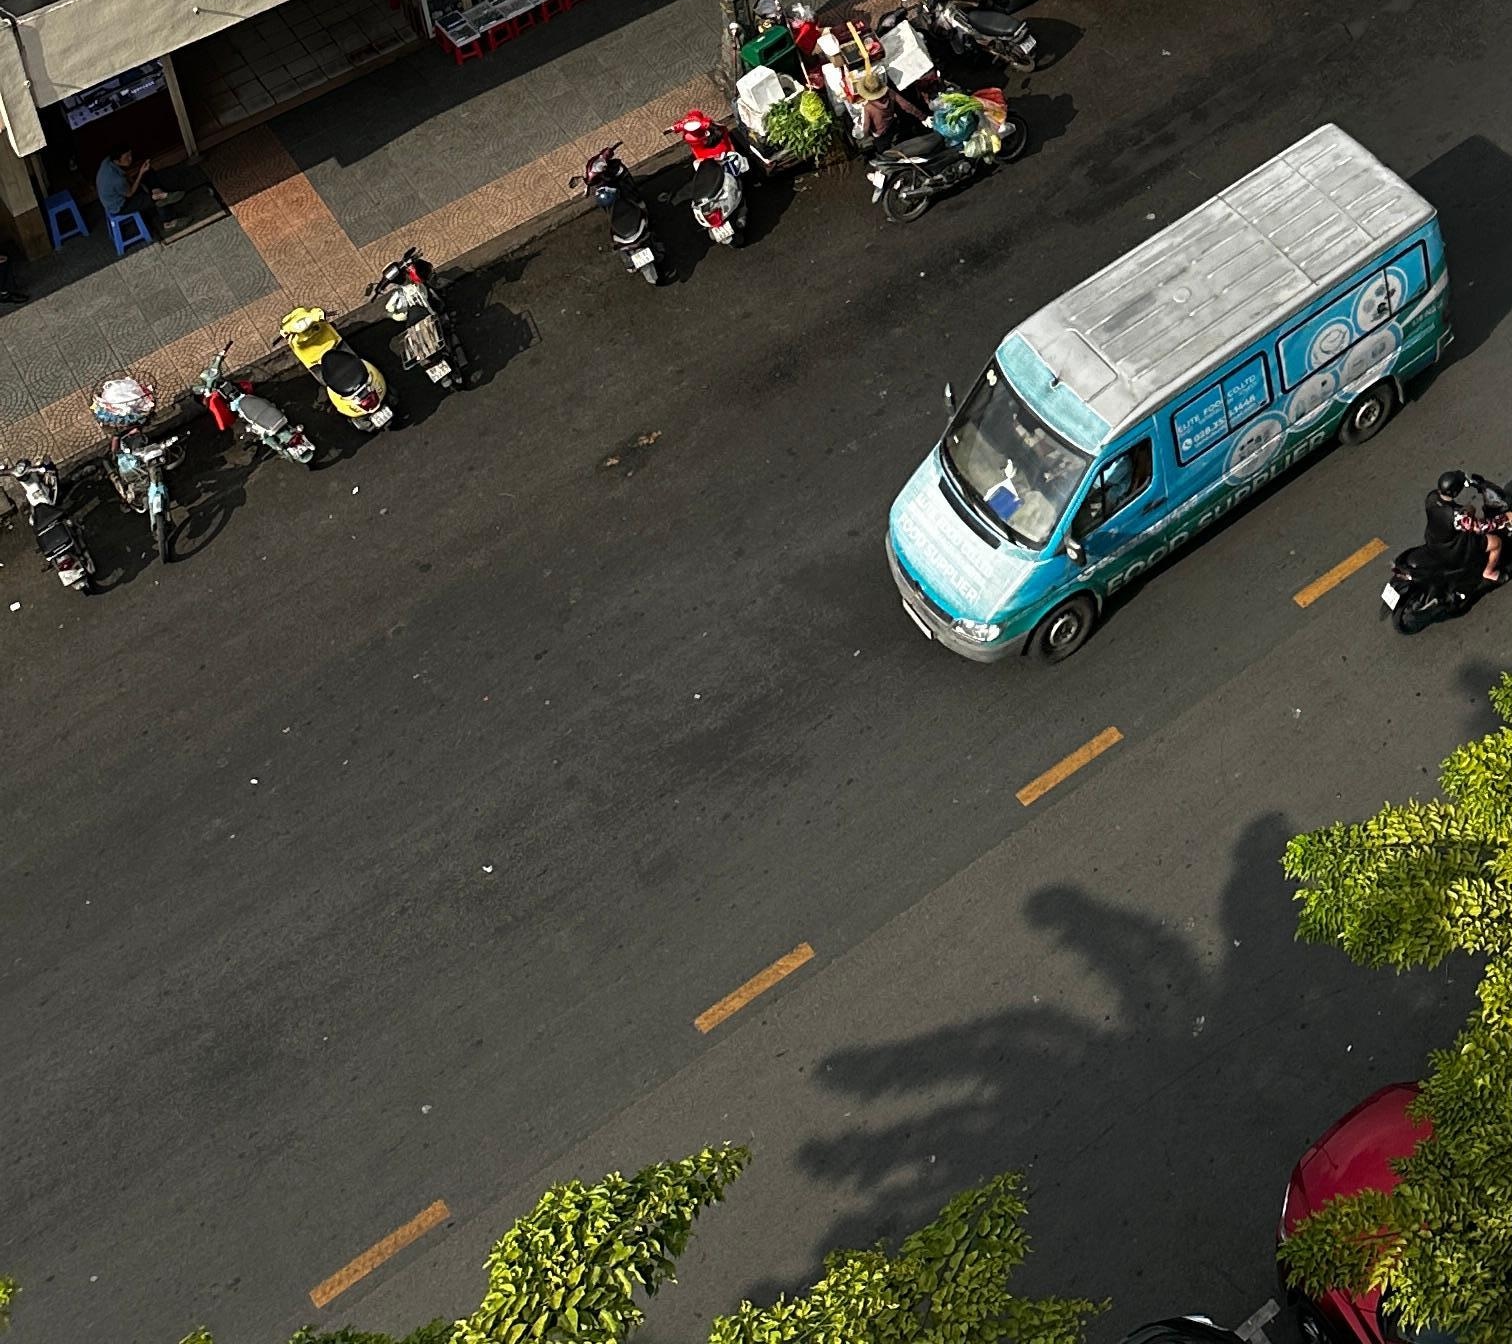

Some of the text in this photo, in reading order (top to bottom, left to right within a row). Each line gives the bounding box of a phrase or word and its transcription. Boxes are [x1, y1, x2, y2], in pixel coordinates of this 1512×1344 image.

[1203, 398, 1224, 417] FOO
[1106, 430, 1328, 596] FOOD SUPPLIER
